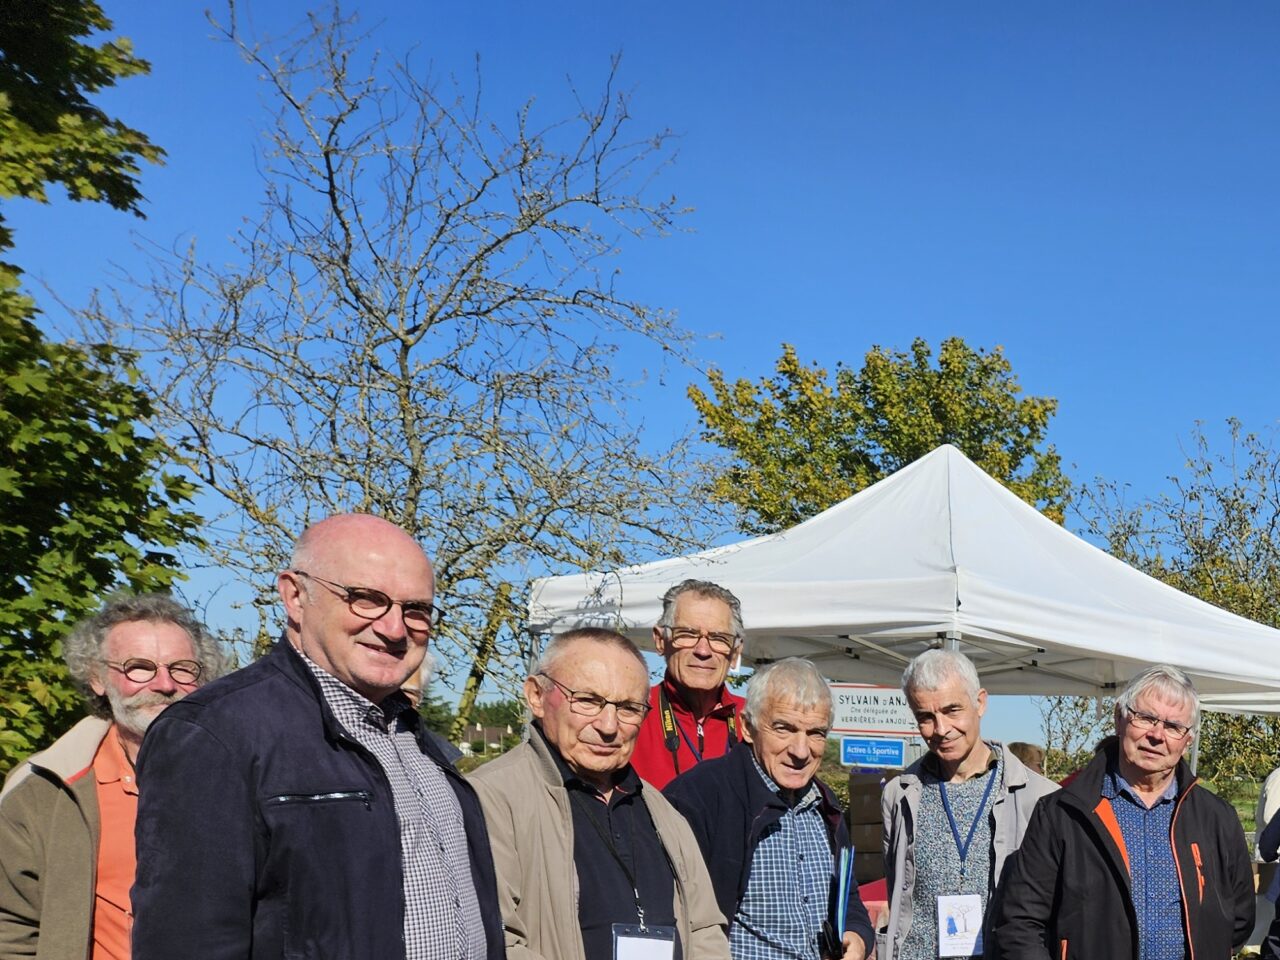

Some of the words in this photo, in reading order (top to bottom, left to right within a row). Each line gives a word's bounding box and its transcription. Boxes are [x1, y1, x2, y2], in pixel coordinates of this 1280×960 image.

[839, 695, 879, 705] SYLVAIN
[883, 696, 907, 706] D'ANJ
[841, 716, 875, 724] VERRIÈRES
[847, 746, 867, 754] Active
[872, 746, 899, 756] Sportive
